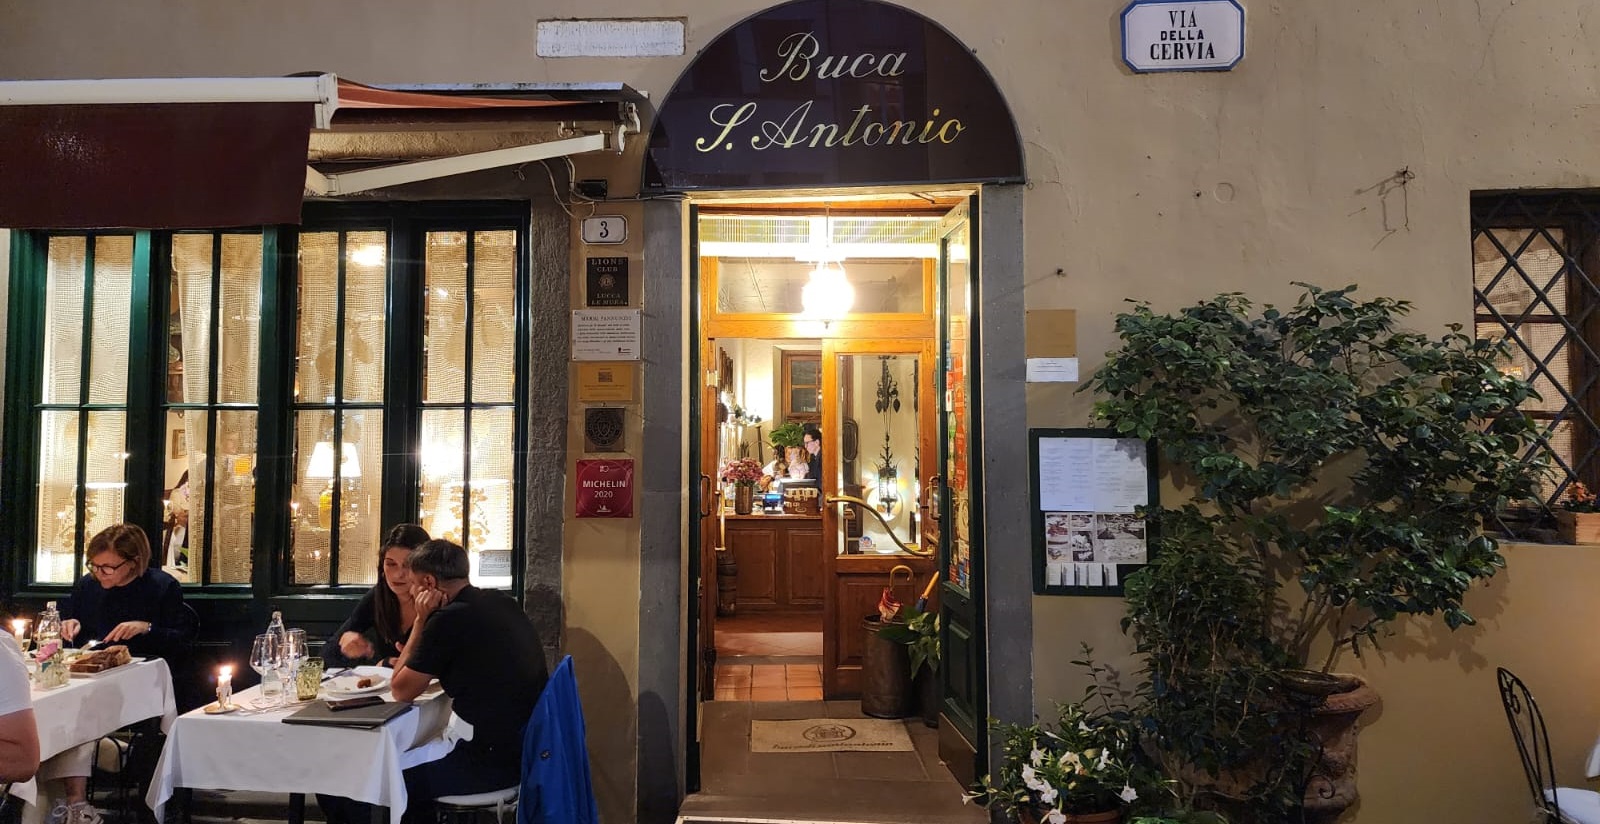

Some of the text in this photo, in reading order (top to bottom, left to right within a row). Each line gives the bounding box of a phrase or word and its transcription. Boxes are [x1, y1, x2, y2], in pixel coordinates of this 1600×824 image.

[1168, 8, 1197, 28] VIA
[1160, 29, 1205, 41] DELLA
[759, 30, 908, 82] Buca
[1150, 42, 1216, 60] CERVIA
[696, 100, 967, 152] S. Antonio
[599, 220, 609, 238] 3
[591, 258, 624, 266] LIONS
[582, 480, 626, 488] MICHELIN
[594, 490, 614, 498] 2020
